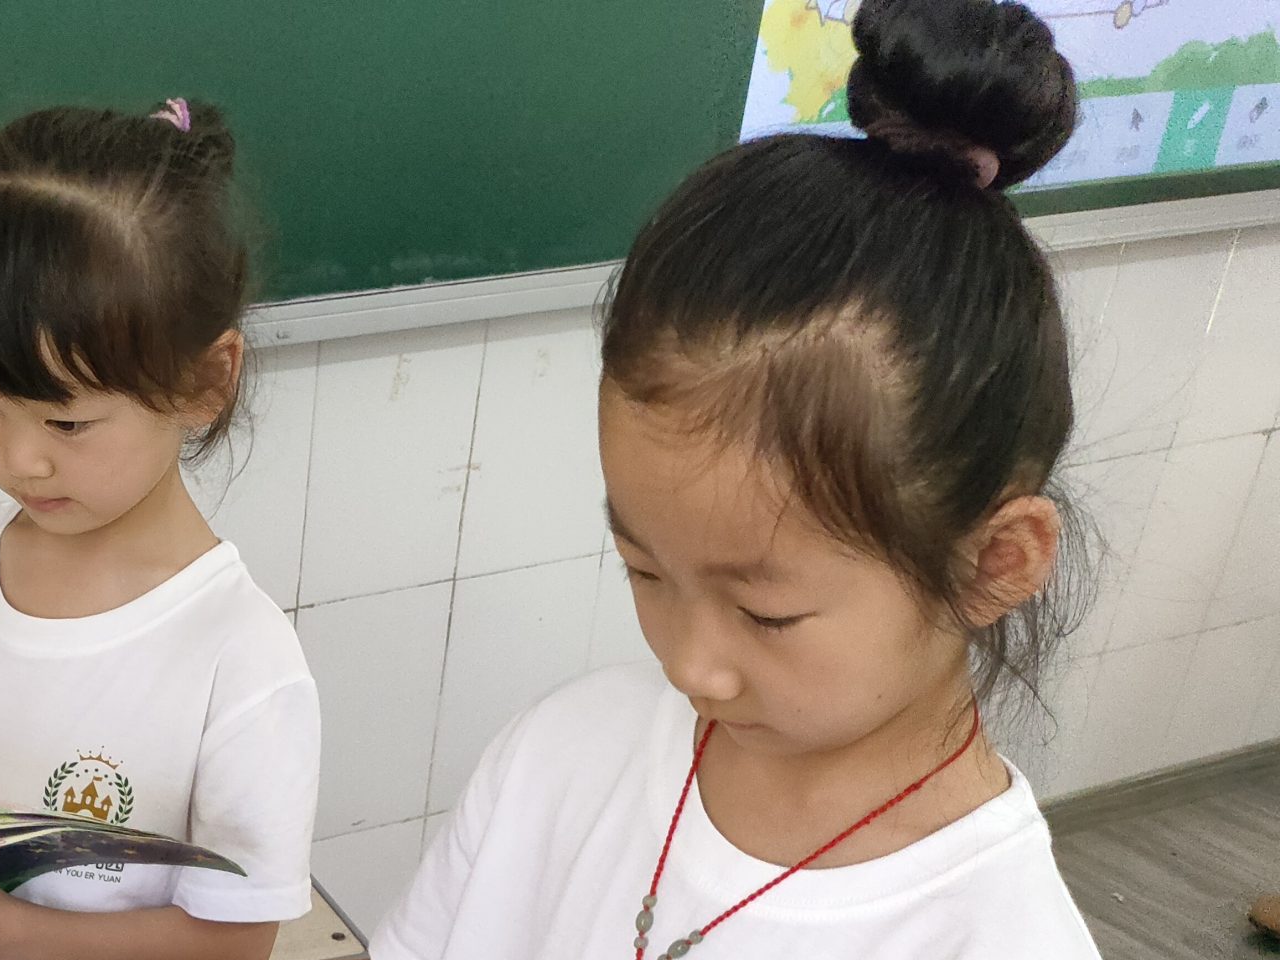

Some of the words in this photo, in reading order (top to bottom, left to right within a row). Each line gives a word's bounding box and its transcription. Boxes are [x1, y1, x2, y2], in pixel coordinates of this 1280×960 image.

[64, 868, 82, 877] YOU
[84, 870, 95, 880] ER
[98, 872, 121, 883] YUAN
